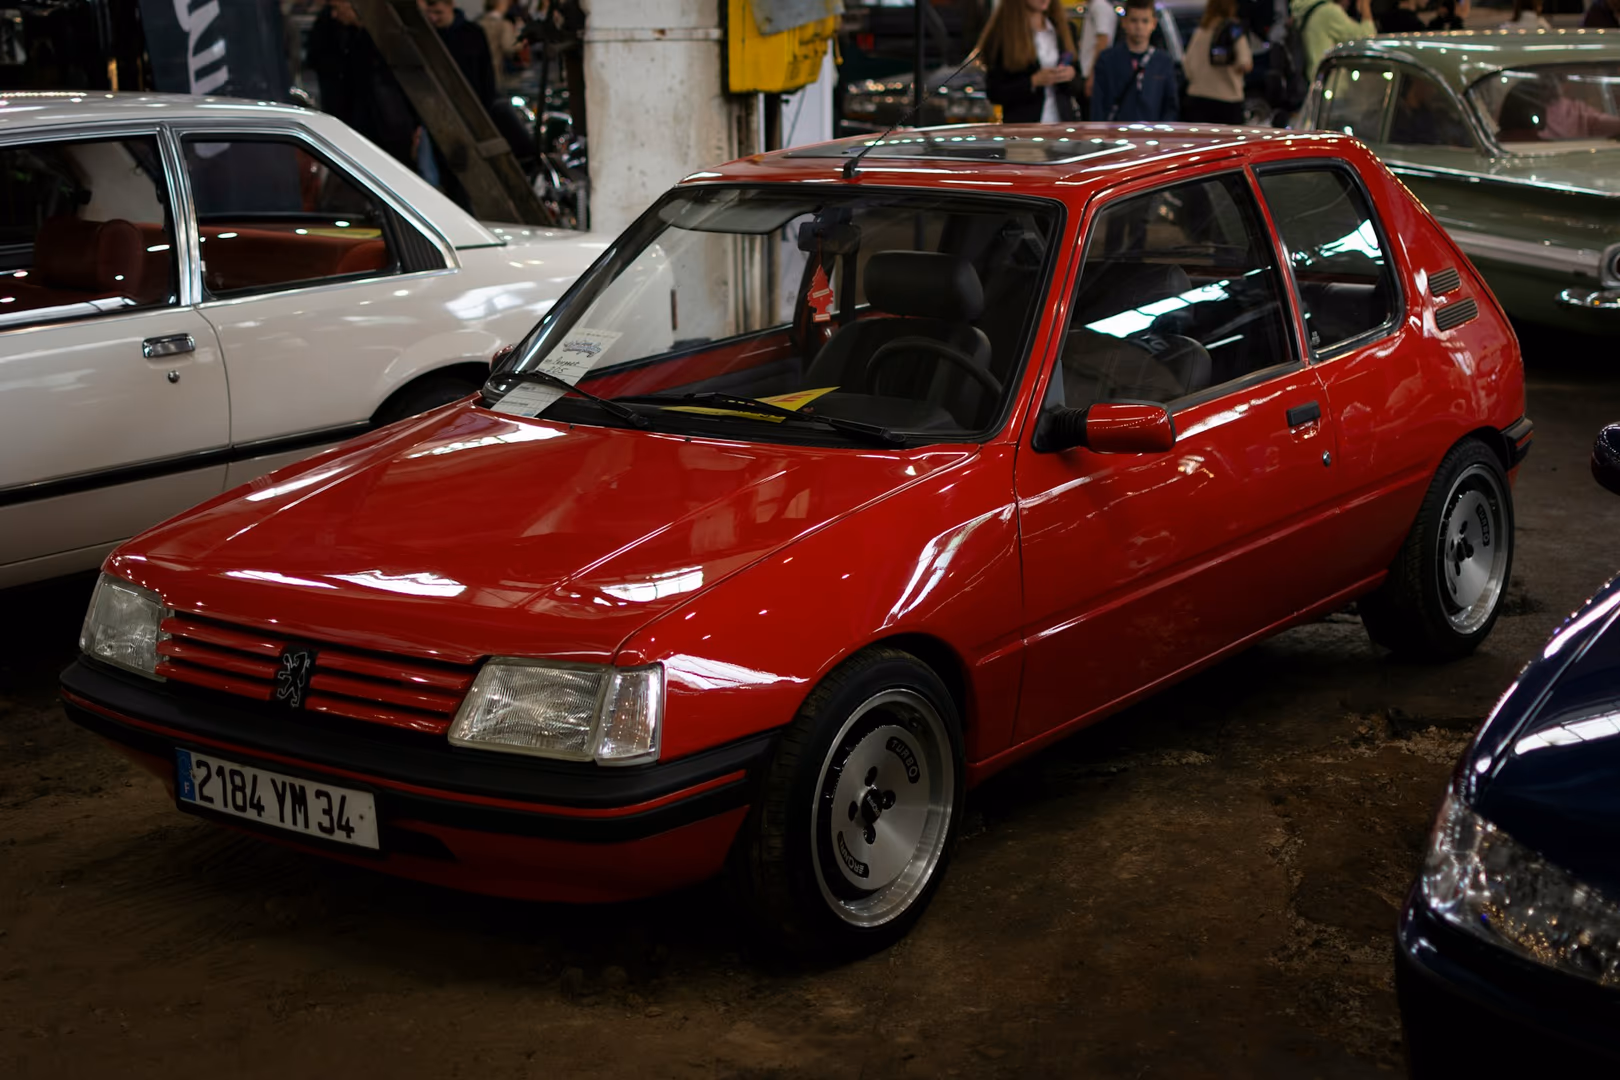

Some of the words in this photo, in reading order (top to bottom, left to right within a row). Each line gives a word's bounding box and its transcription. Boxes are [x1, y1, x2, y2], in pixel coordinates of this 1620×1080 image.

[889, 739, 918, 777] TURBO
[183, 782, 190, 794] F
[195, 759, 265, 818] 2184
[270, 778, 310, 830] YM
[314, 789, 355, 839] 34
